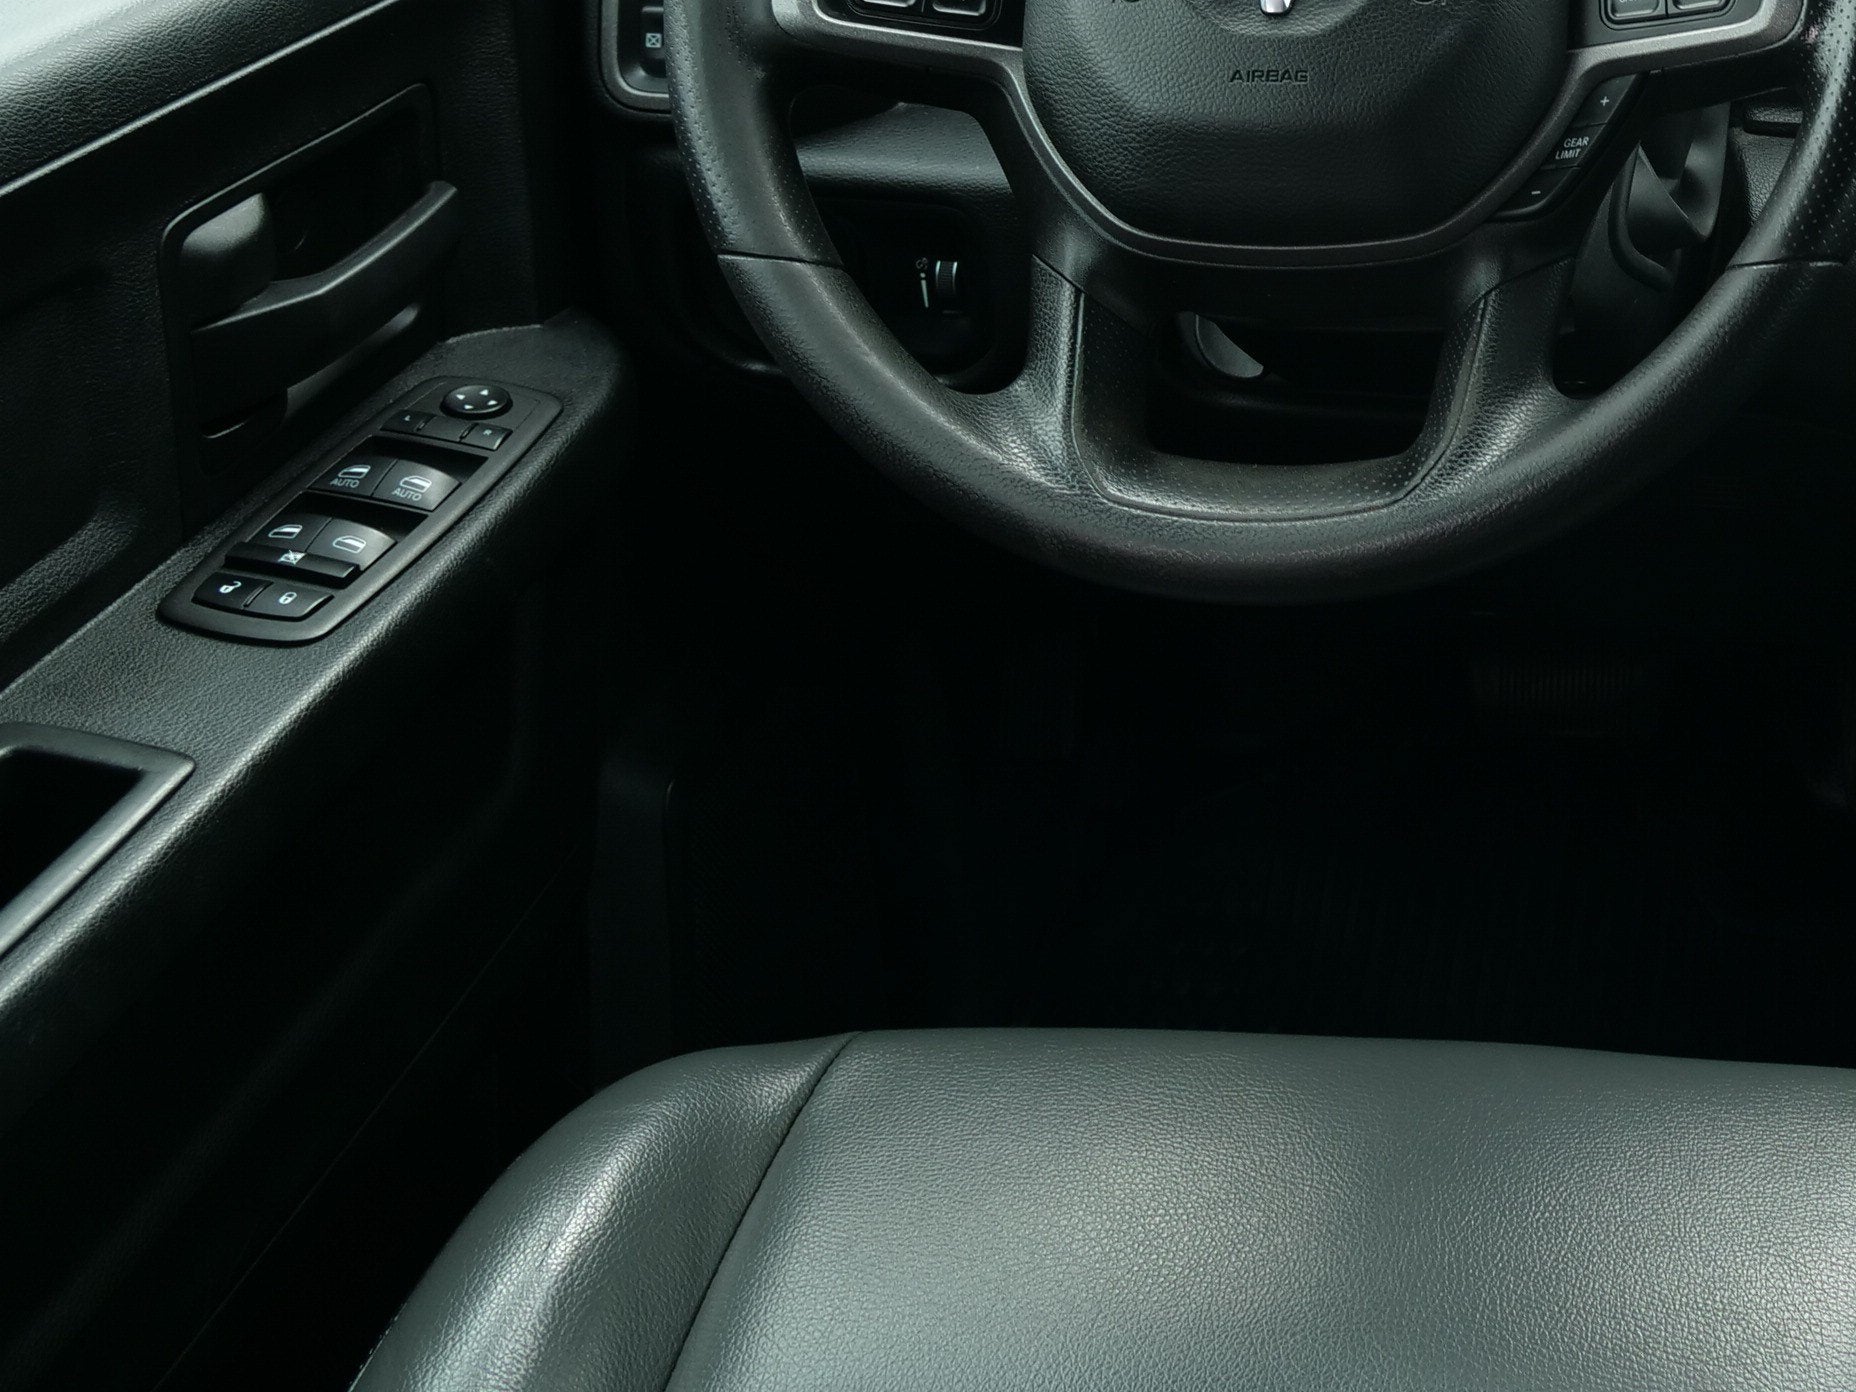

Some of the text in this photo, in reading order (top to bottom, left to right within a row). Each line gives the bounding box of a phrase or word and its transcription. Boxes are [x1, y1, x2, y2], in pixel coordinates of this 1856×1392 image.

[1229, 69, 1309, 83] AIRBAG
[1563, 136, 1590, 148] GEAR
[1555, 148, 1581, 160] LIMIT
[330, 478, 359, 488] AUTO
[392, 488, 422, 501] AUTO
